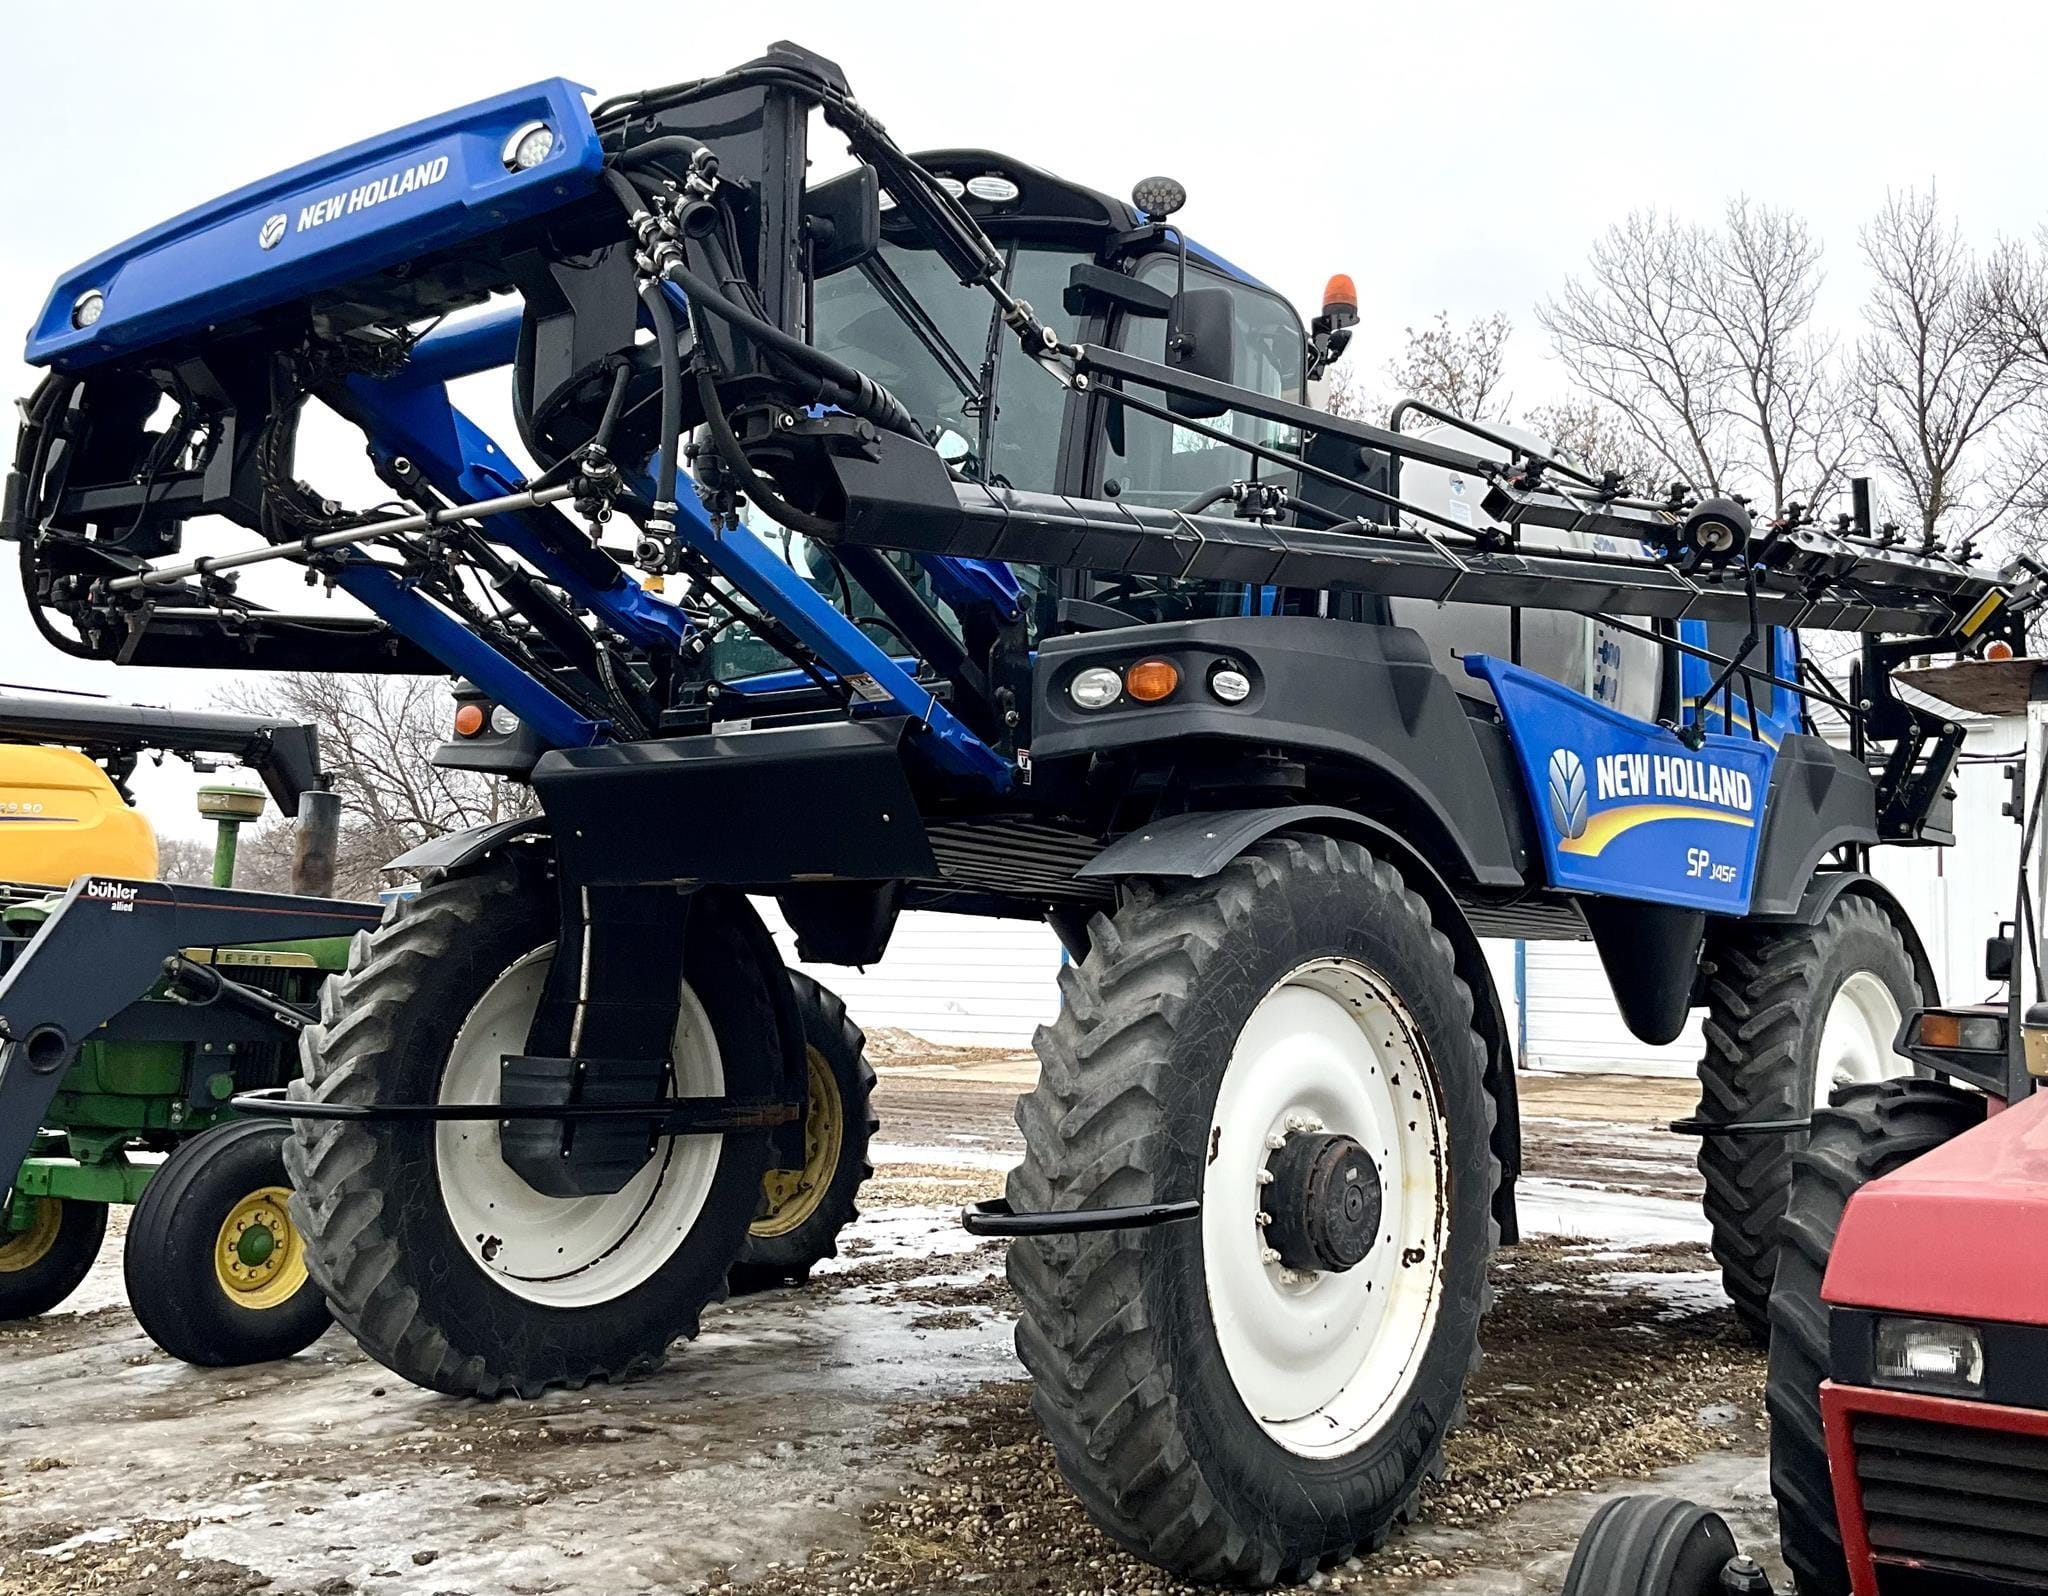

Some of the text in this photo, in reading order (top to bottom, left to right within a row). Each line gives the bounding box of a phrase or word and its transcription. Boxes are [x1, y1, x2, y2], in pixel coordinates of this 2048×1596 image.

[297, 156, 449, 232] NEW HOLLAND
[1596, 754, 1752, 811] NEW HOLLAND
[1686, 847, 1710, 877] SP
[87, 880, 138, 900] bühler
[111, 901, 134, 912] allied
